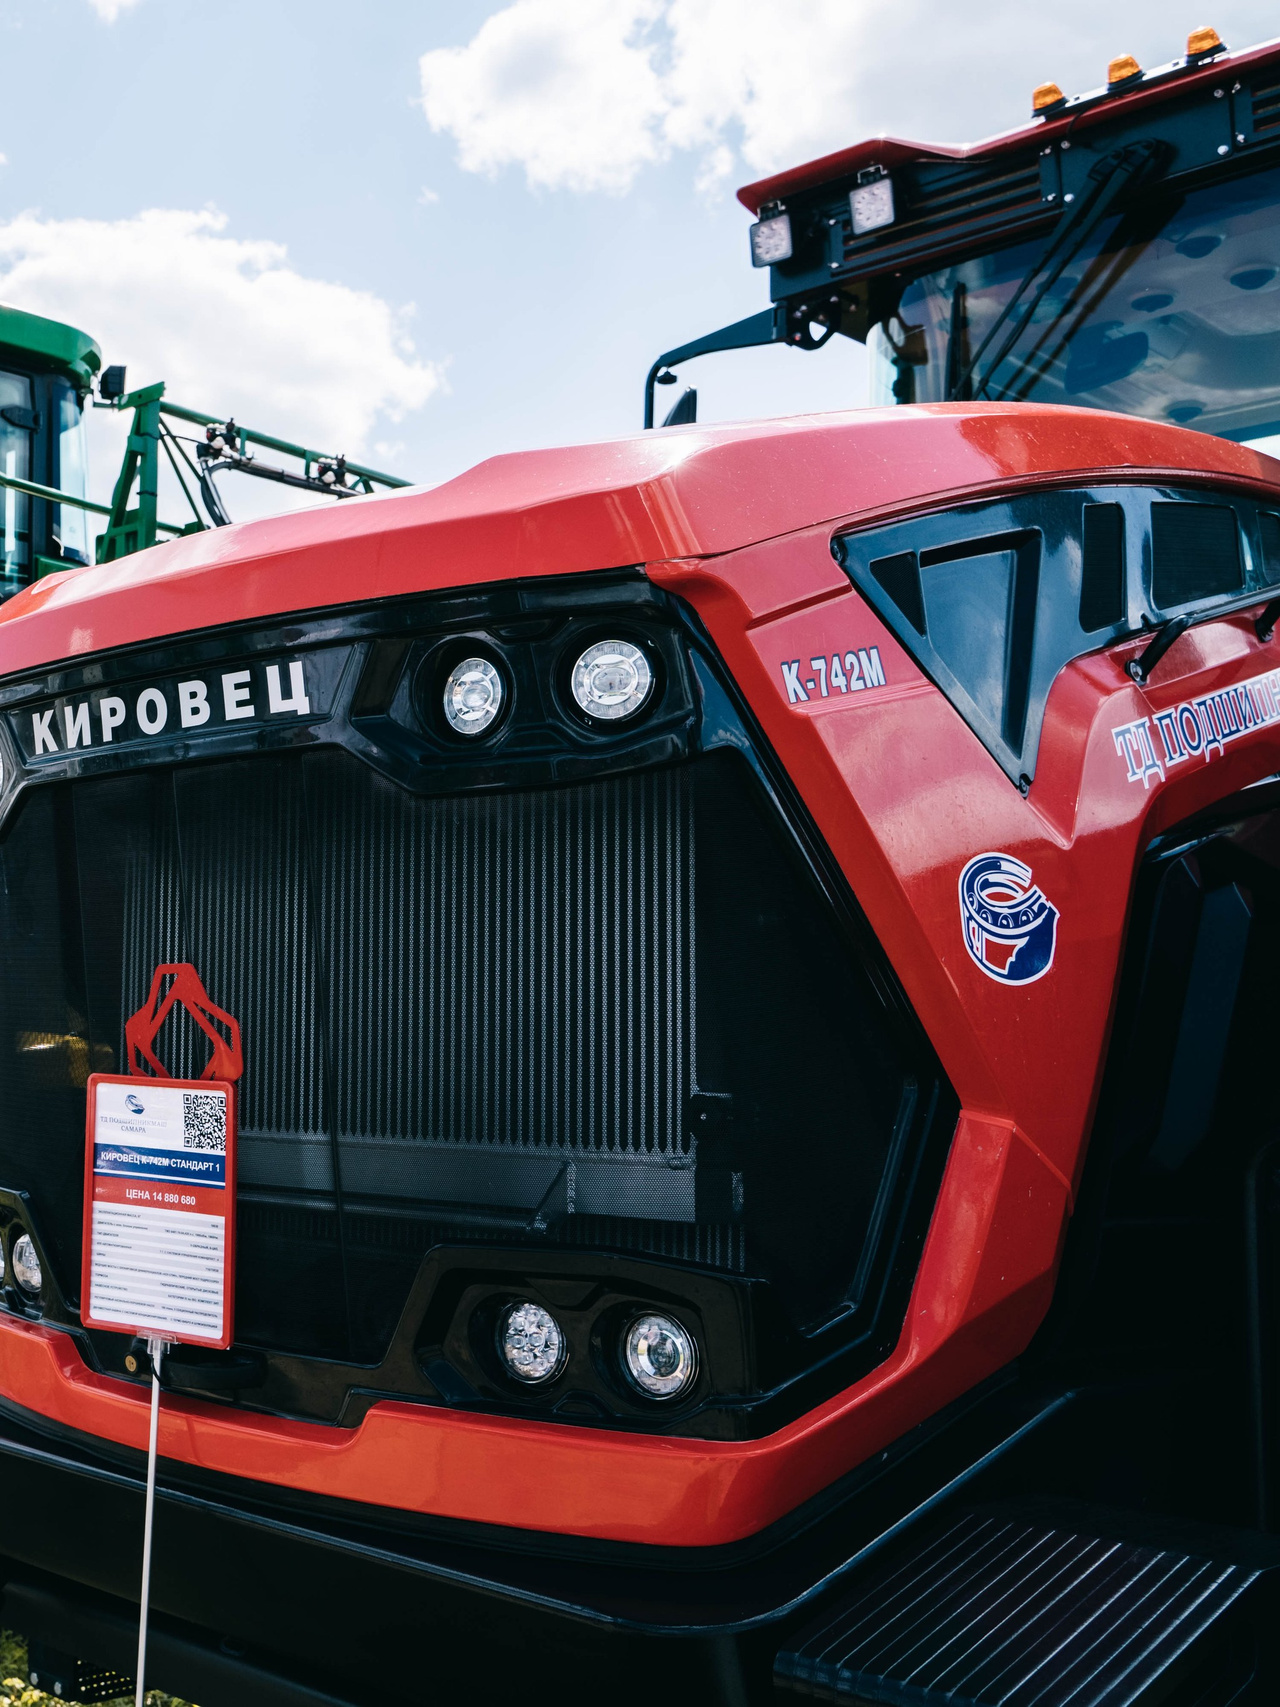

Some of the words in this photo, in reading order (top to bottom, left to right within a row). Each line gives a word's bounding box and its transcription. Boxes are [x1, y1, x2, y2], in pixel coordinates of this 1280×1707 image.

[781, 645, 887, 704] К-742М
[32, 661, 310, 755] КИРОВЕЦ
[1111, 716, 1165, 789] ТД
[120, 1125, 147, 1134] САМАРА
[100, 1152, 140, 1165] КИРОВЕЦ
[141, 1156, 169, 1167] К-742М
[170, 1158, 214, 1172] СТАНДАРТ
[215, 1163, 220, 1172] 1
[125, 1188, 150, 1200] ЦЕНА
[152, 1192, 162, 1202] 14
[164, 1193, 179, 1204] 880
[181, 1195, 196, 1206] 680
